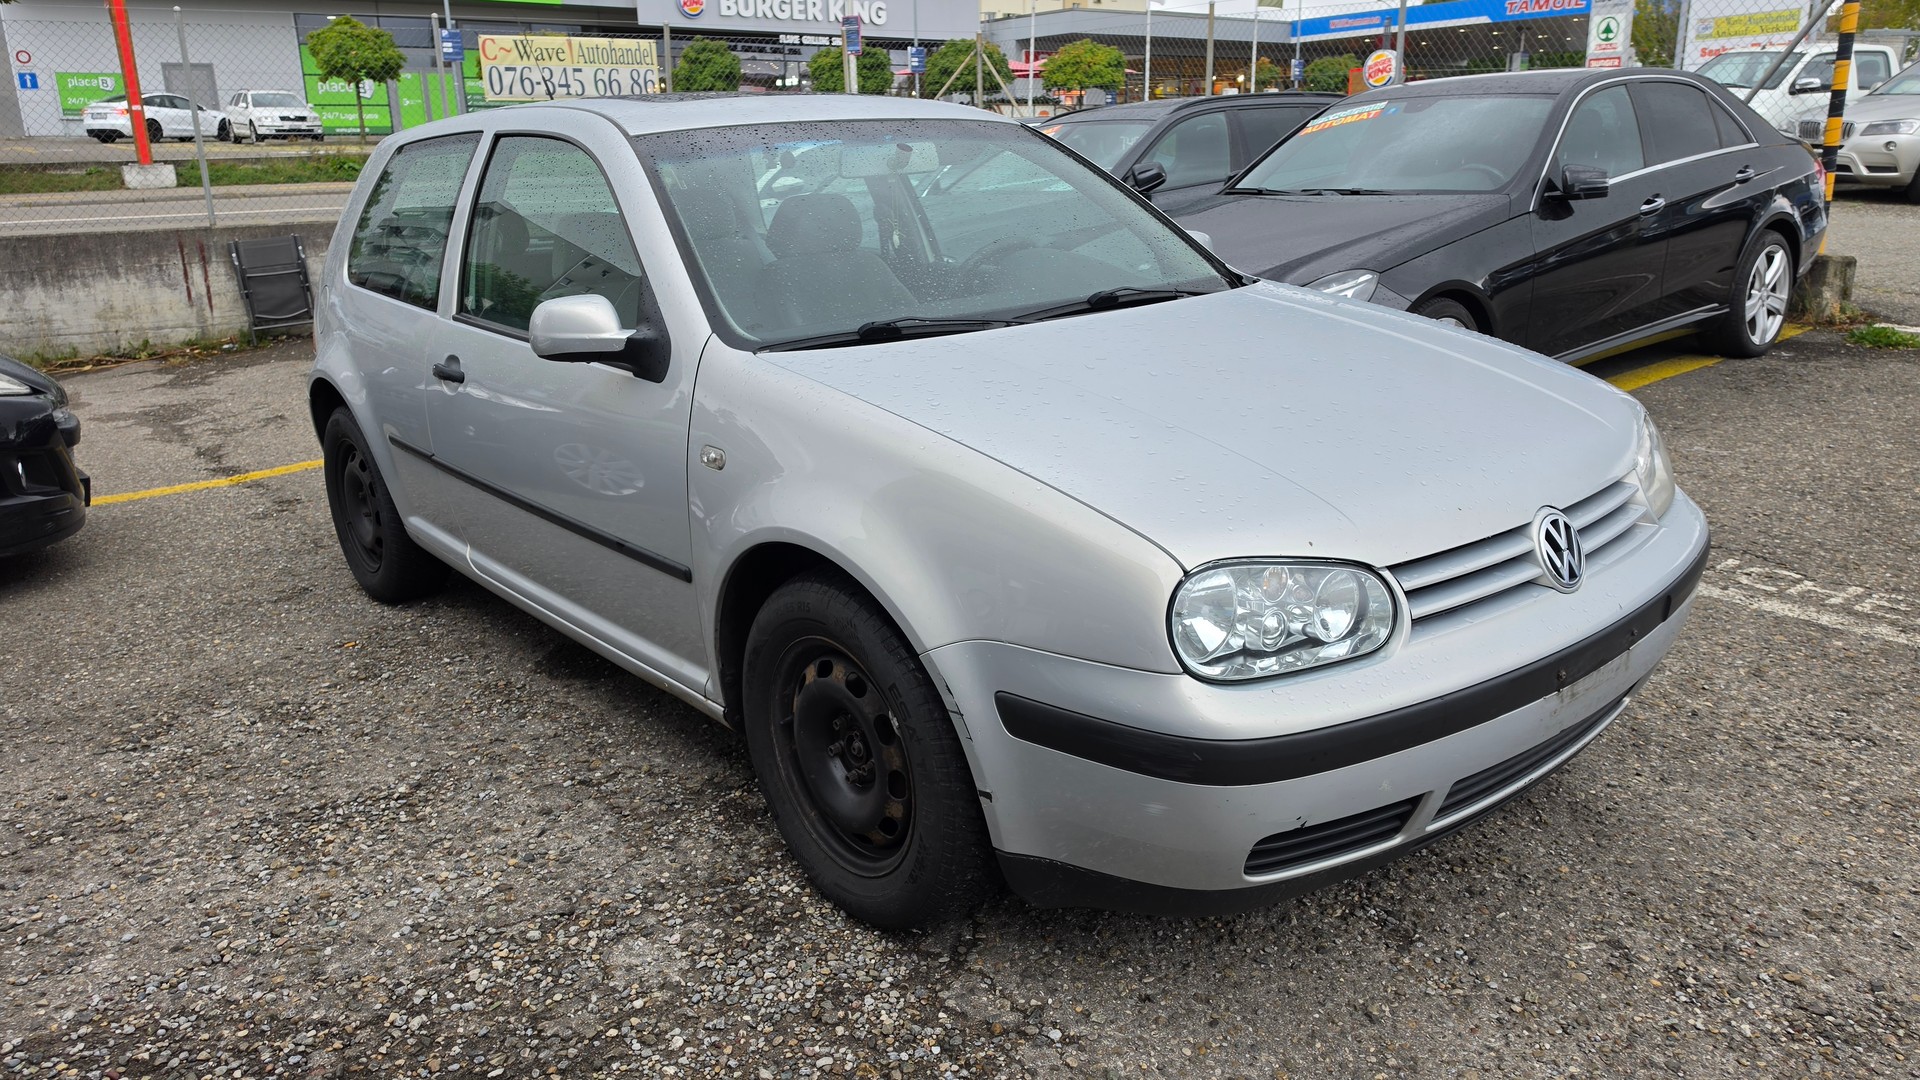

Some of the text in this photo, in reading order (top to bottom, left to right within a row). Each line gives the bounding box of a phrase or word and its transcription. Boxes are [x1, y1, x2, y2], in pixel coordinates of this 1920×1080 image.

[720, 0, 823, 21] BURGER
[576, 40, 656, 66] Autohandel
[488, 65, 656, 97] 076-345 66 86
[1368, 64, 1392, 80] KING
[1300, 112, 1380, 136] AUTOMAT
